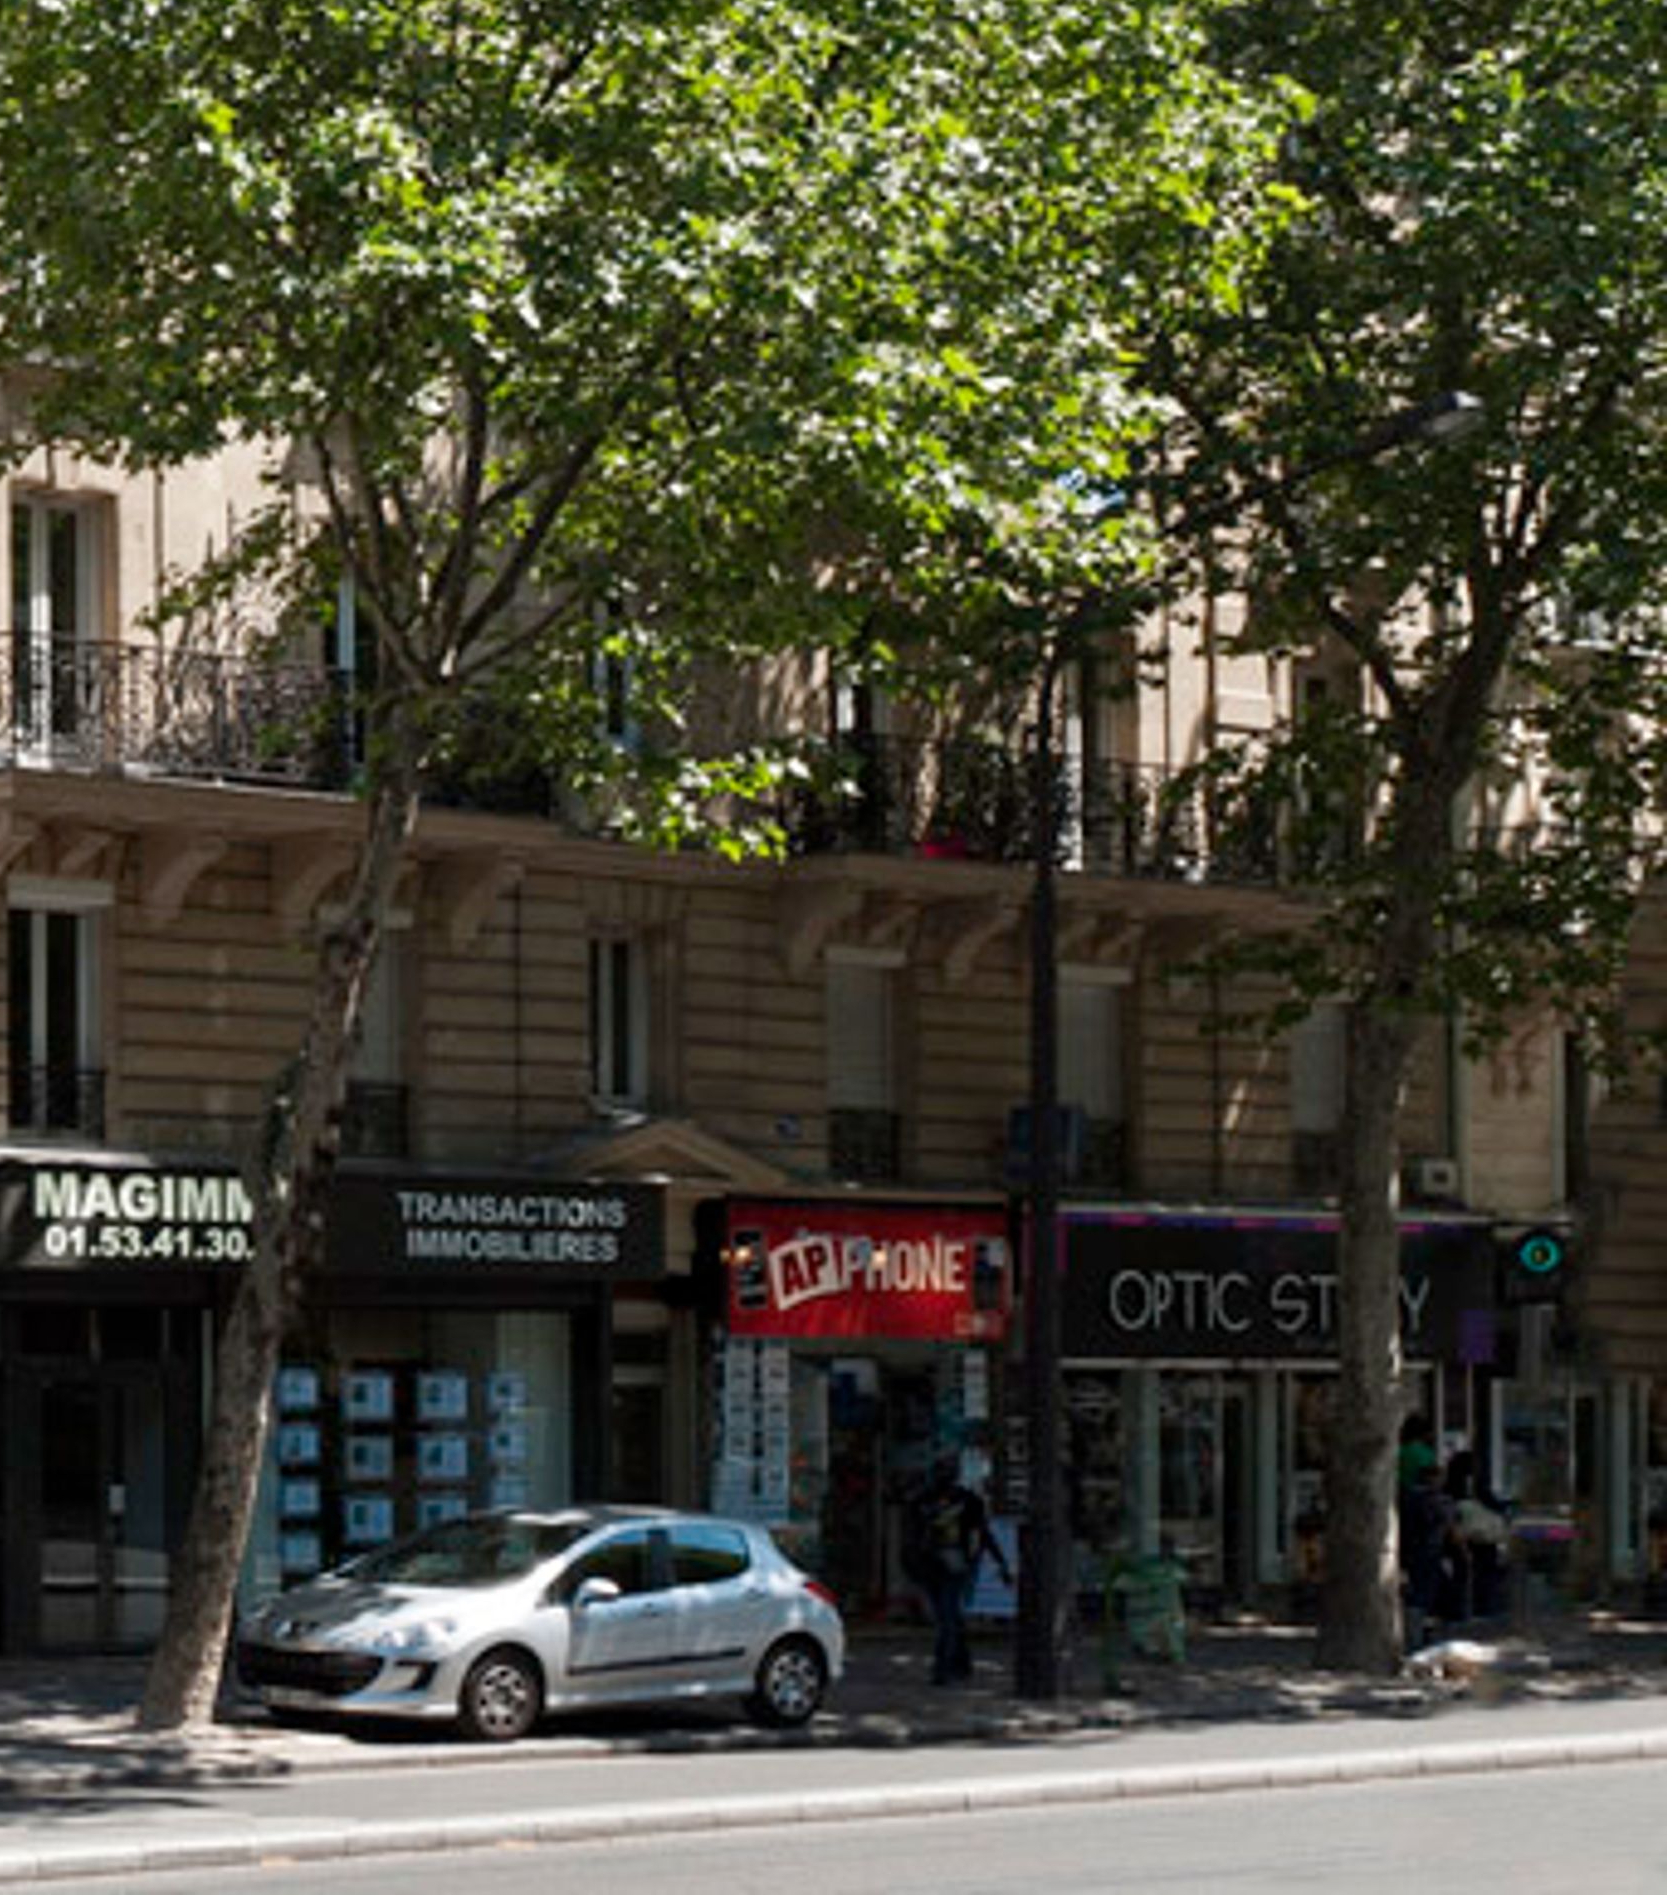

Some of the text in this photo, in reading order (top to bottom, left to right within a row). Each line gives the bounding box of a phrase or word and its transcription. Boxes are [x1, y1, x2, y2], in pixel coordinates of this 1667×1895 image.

[396, 1191, 628, 1228] TRANSACTIONS
[406, 1229, 620, 1262] IMMOBILIERES
[1109, 1269, 1251, 1331] OPTIC
